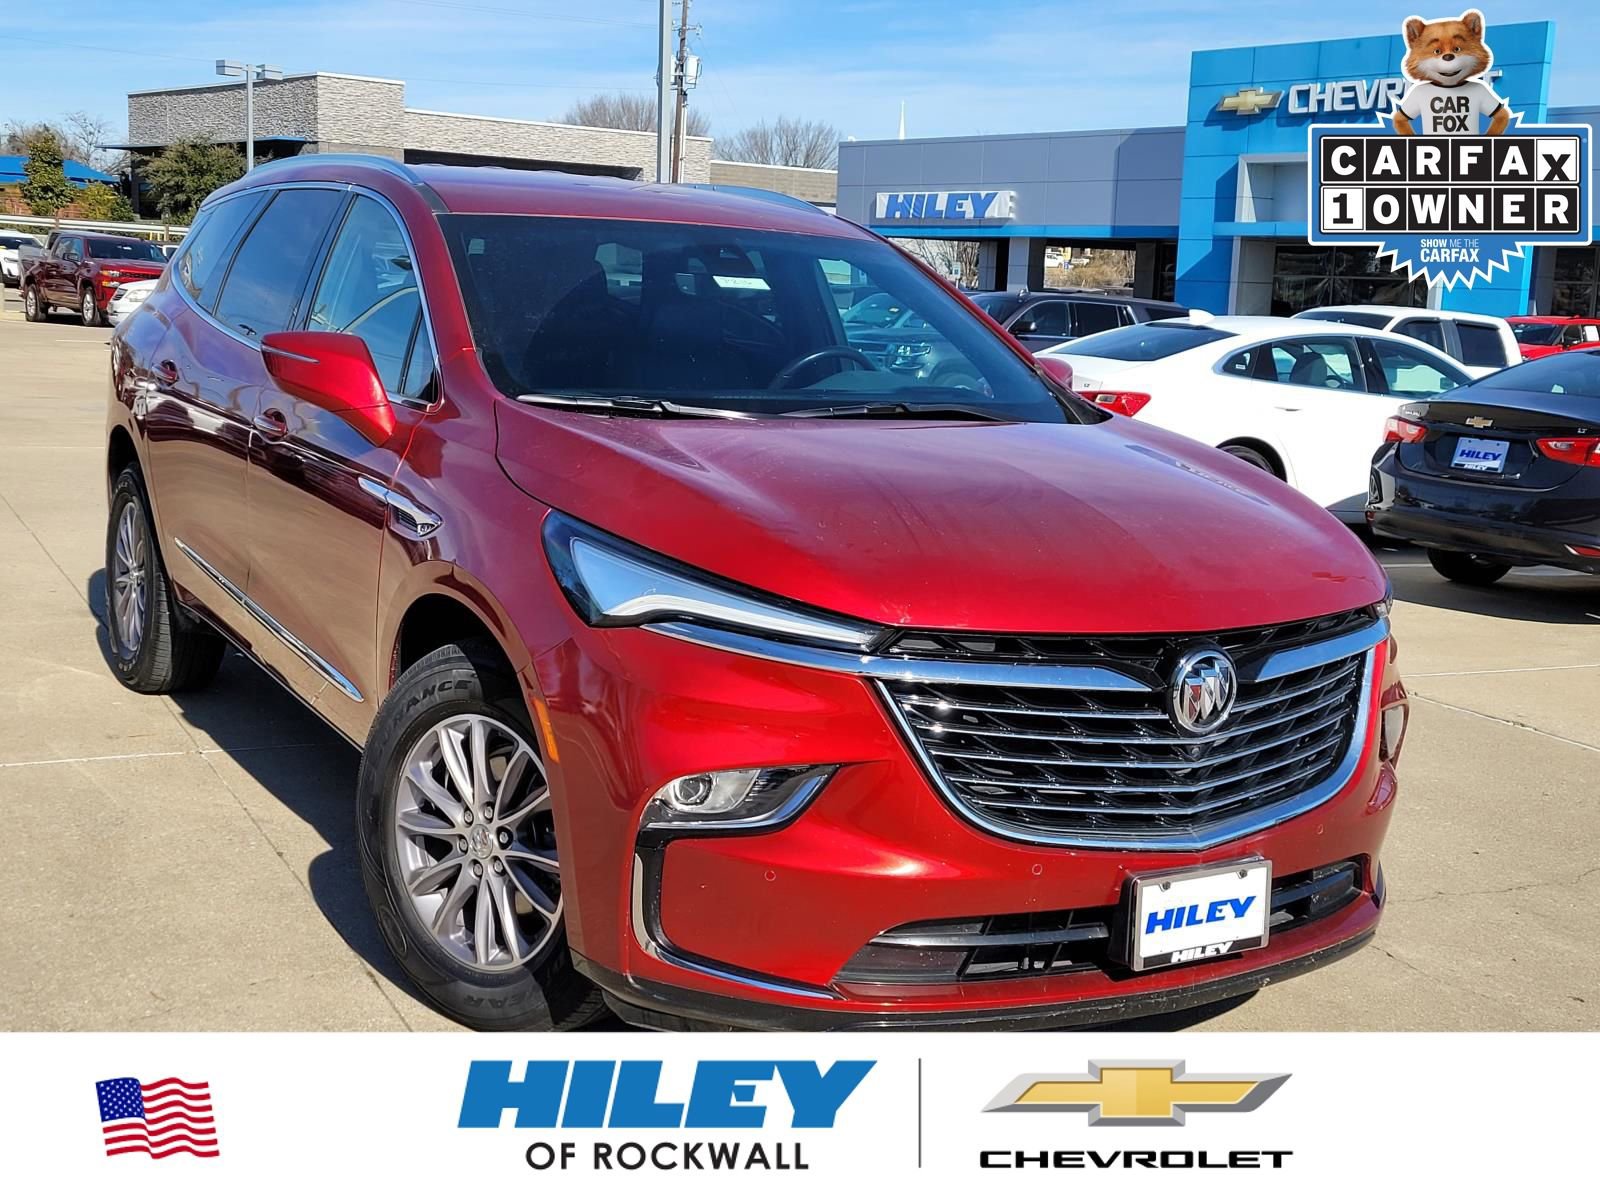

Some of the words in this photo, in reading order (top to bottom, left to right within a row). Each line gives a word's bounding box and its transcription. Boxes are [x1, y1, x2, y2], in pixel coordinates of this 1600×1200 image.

[885, 192, 998, 219] HILEY
[1459, 449, 1502, 461] HILEY
[1145, 895, 1257, 935] HILEY
[1170, 941, 1234, 963] HILEY
